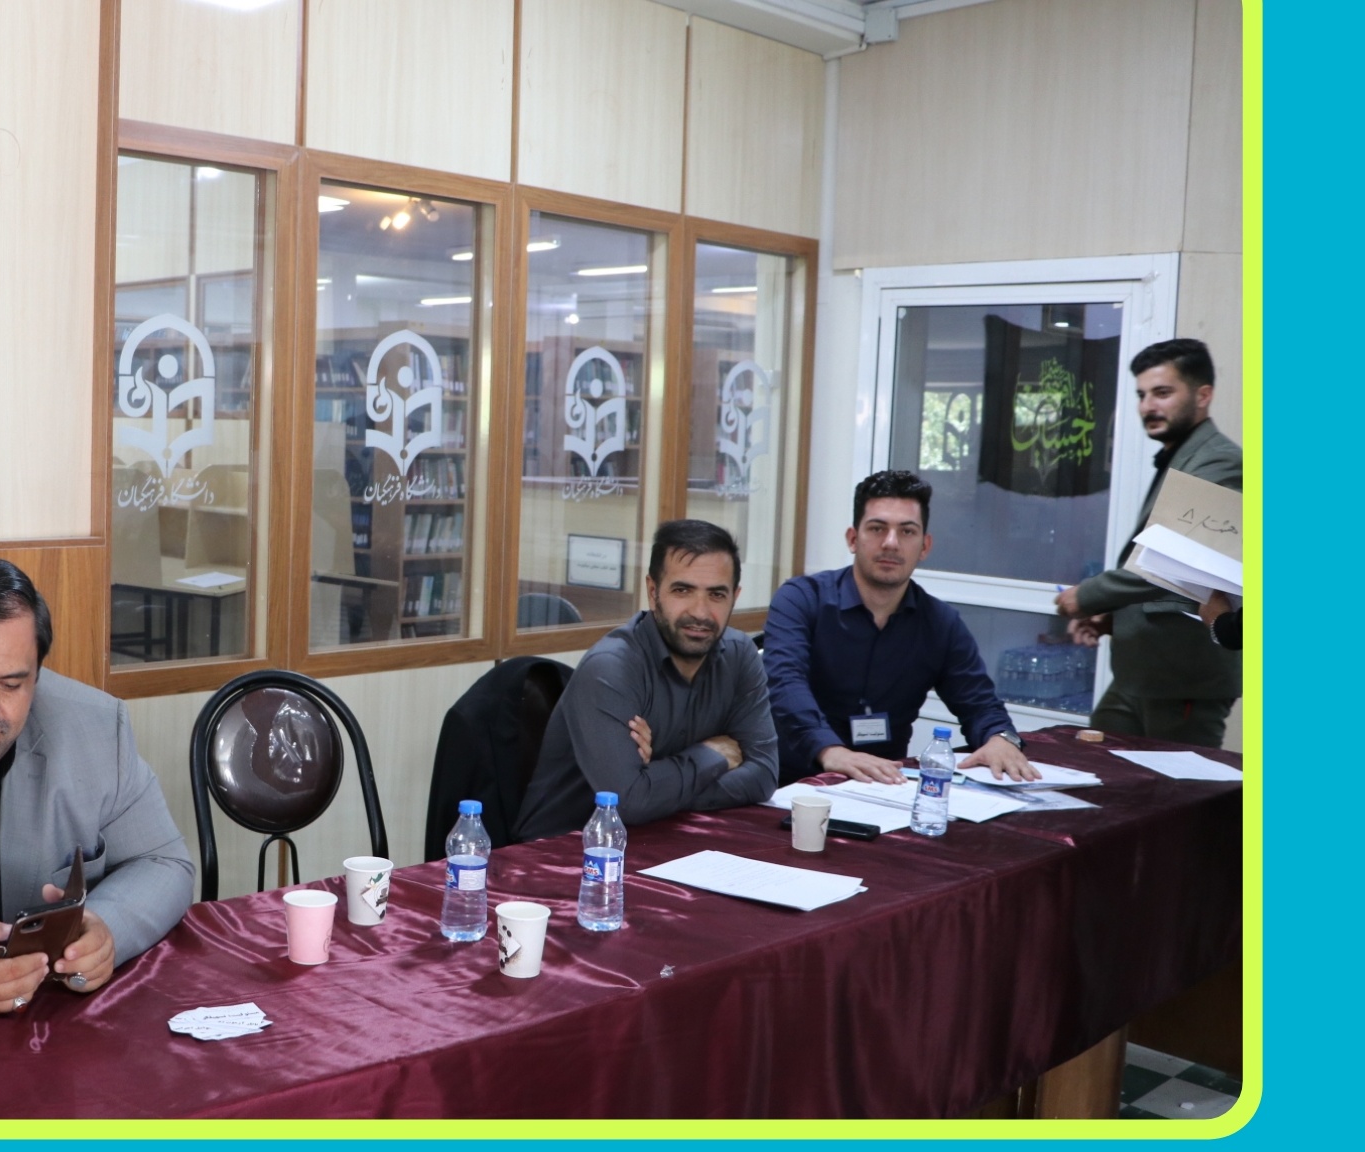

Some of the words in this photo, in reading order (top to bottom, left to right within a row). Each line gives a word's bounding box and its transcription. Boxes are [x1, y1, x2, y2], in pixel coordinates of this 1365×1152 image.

[117, 474, 165, 512] فرهنگیان
[162, 477, 215, 506] دانشگاه
[363, 473, 402, 507] فرهنگیان
[399, 474, 442, 501] دانشگاه
